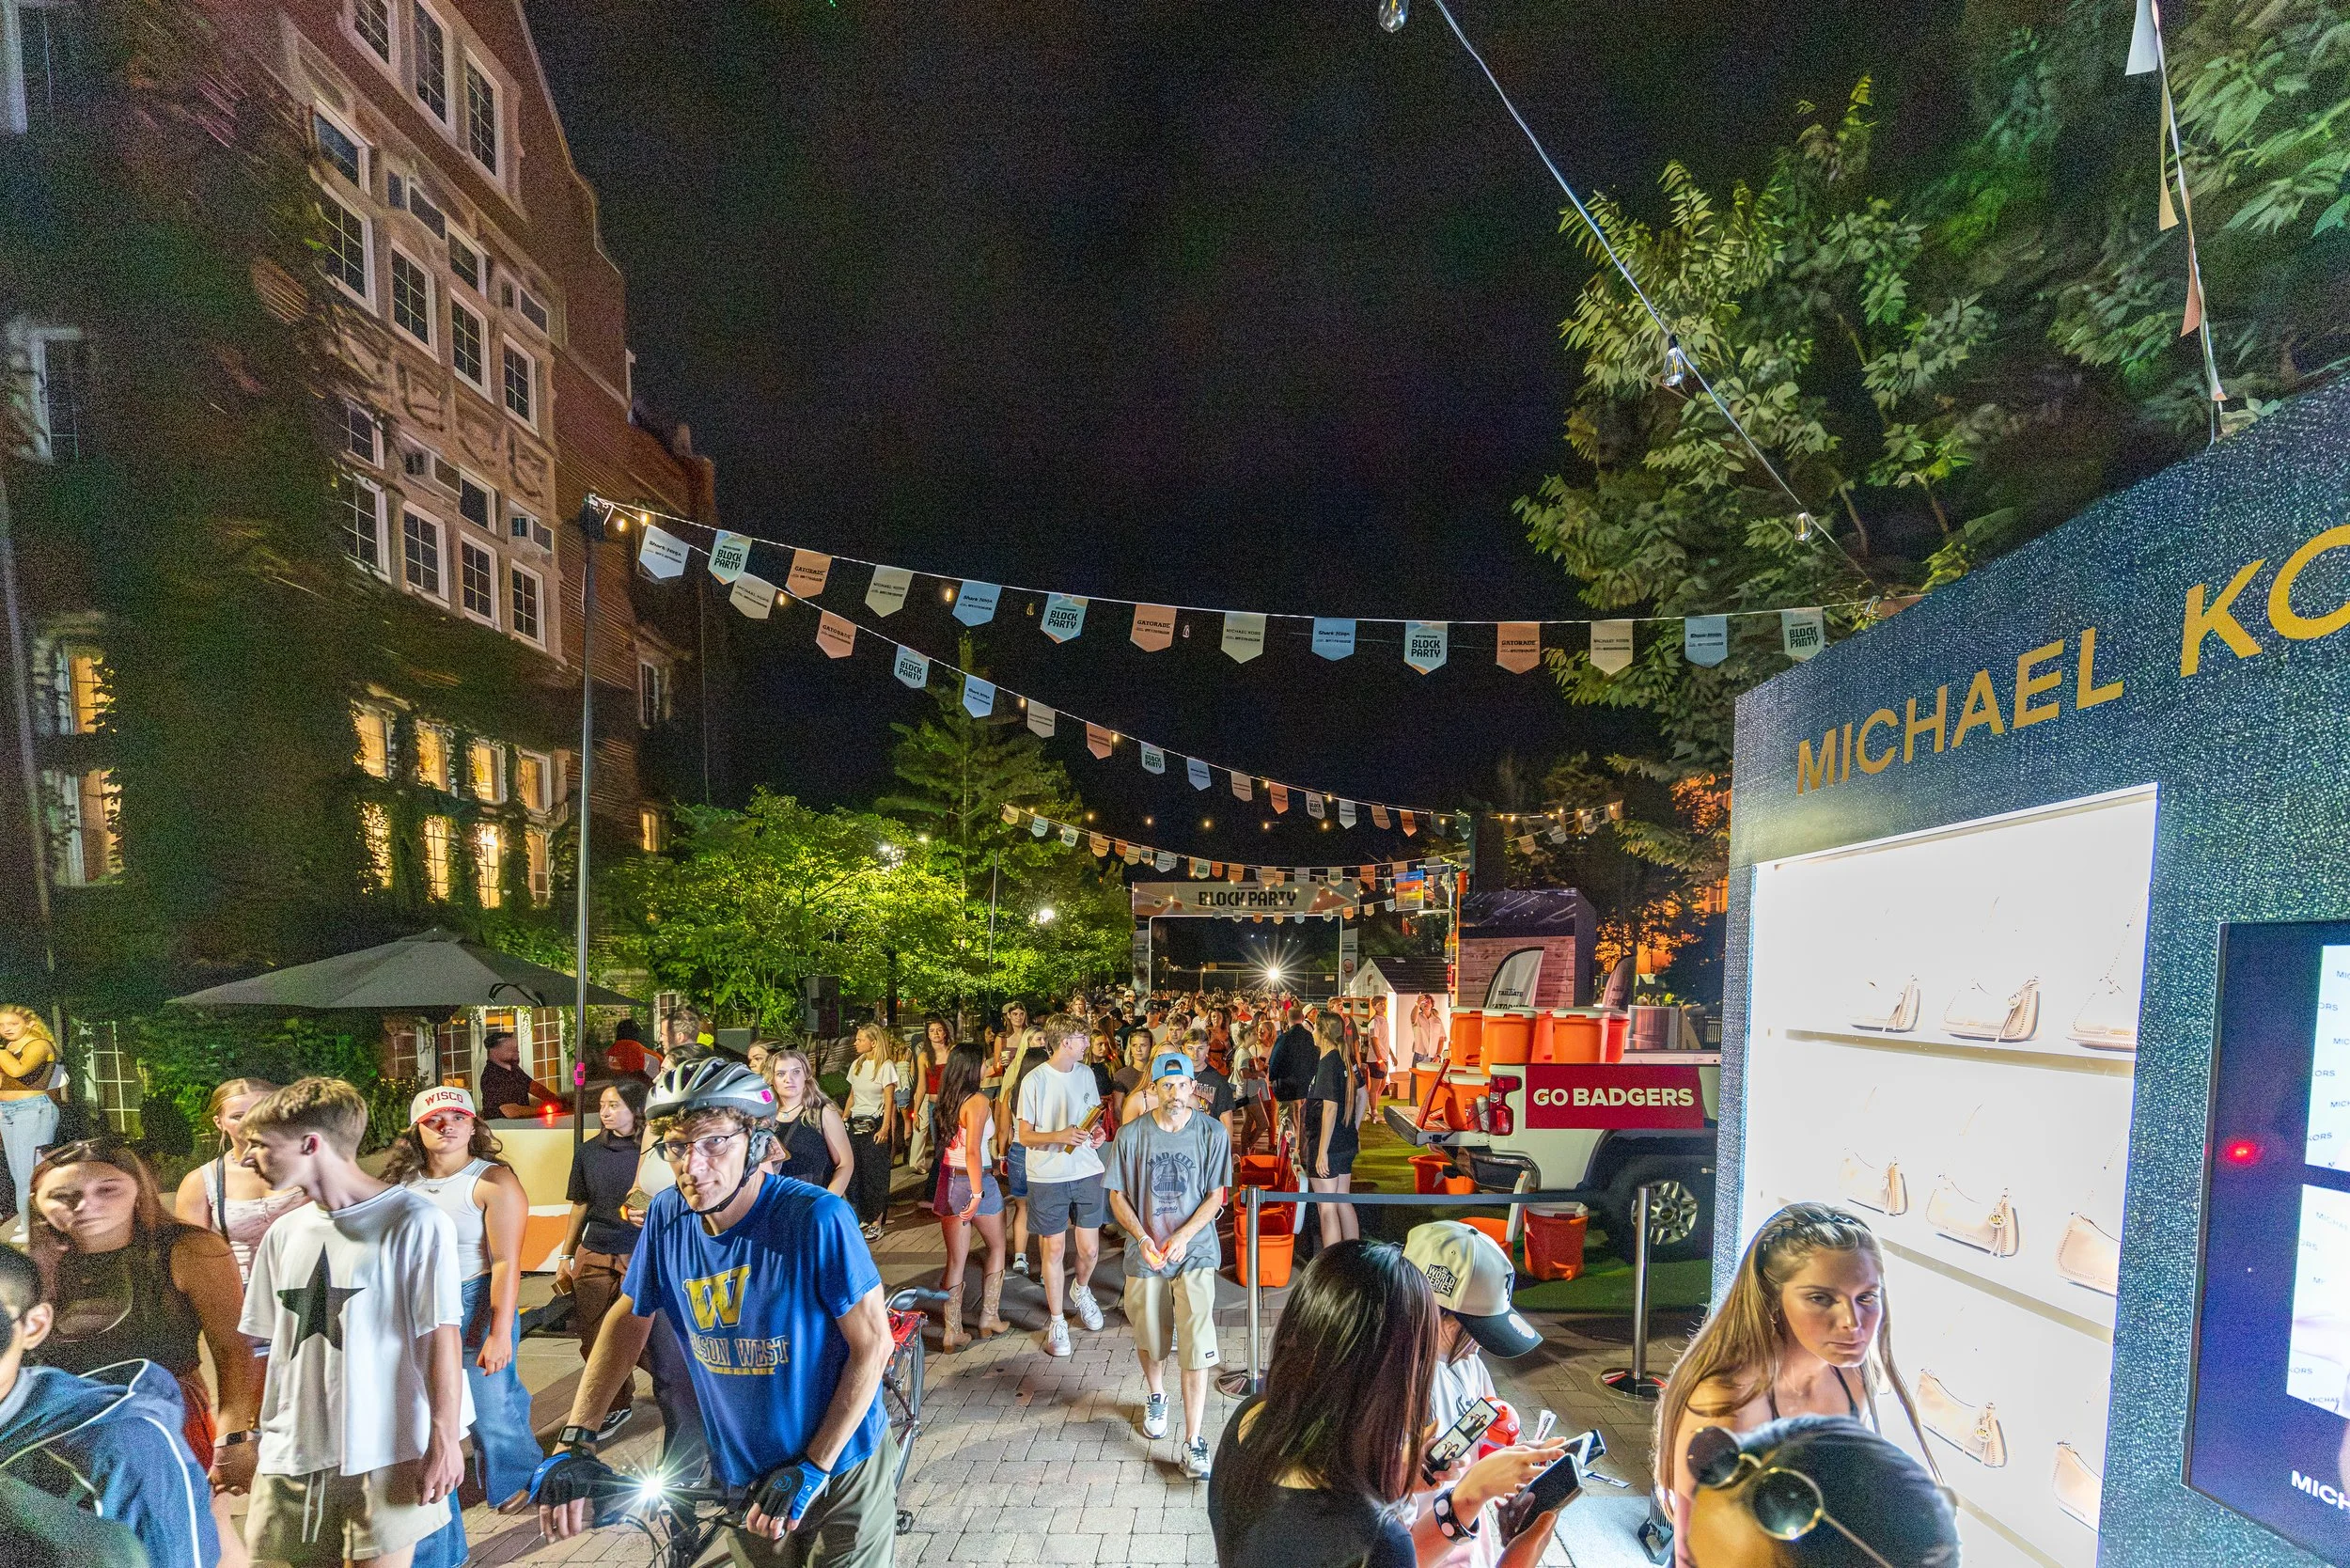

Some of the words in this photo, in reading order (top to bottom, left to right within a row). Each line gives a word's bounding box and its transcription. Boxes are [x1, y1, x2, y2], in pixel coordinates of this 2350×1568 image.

[716, 549, 743, 562] BLOCK
[713, 558, 741, 571] PARTY
[794, 566, 826, 576] GATORADE
[1050, 610, 1078, 621] BLOCK
[1047, 619, 1076, 630] PARTY
[1136, 619, 1171, 629] GATORADE
[822, 624, 853, 639] GATORADE
[1789, 626, 1817, 638] BLOCK
[1412, 639, 1440, 649] BLOCK
[1790, 635, 1819, 649] PARTY
[1411, 649, 1440, 658] PARTY
[899, 667, 922, 682] PARTY
[900, 661, 922, 675] BLOCK
[1796, 627, 2124, 795] MICHAEL
[1145, 754, 1162, 762] BLOCK
[1198, 891, 1245, 906] BLOCK
[1248, 891, 1297, 906] PARTY
[425, 1090, 464, 1106] WISCO
[1533, 1088, 1572, 1106] GO
[1573, 1088, 1694, 1106] BADGERS
[1147, 1152, 1169, 1168] MAD
[1174, 1152, 1197, 1168] CITY
[1428, 1265, 1456, 1287] WORLD
[1426, 1274, 1453, 1295] SERIES
[682, 1263, 752, 1333] W
[734, 1335, 791, 1368] WEST
